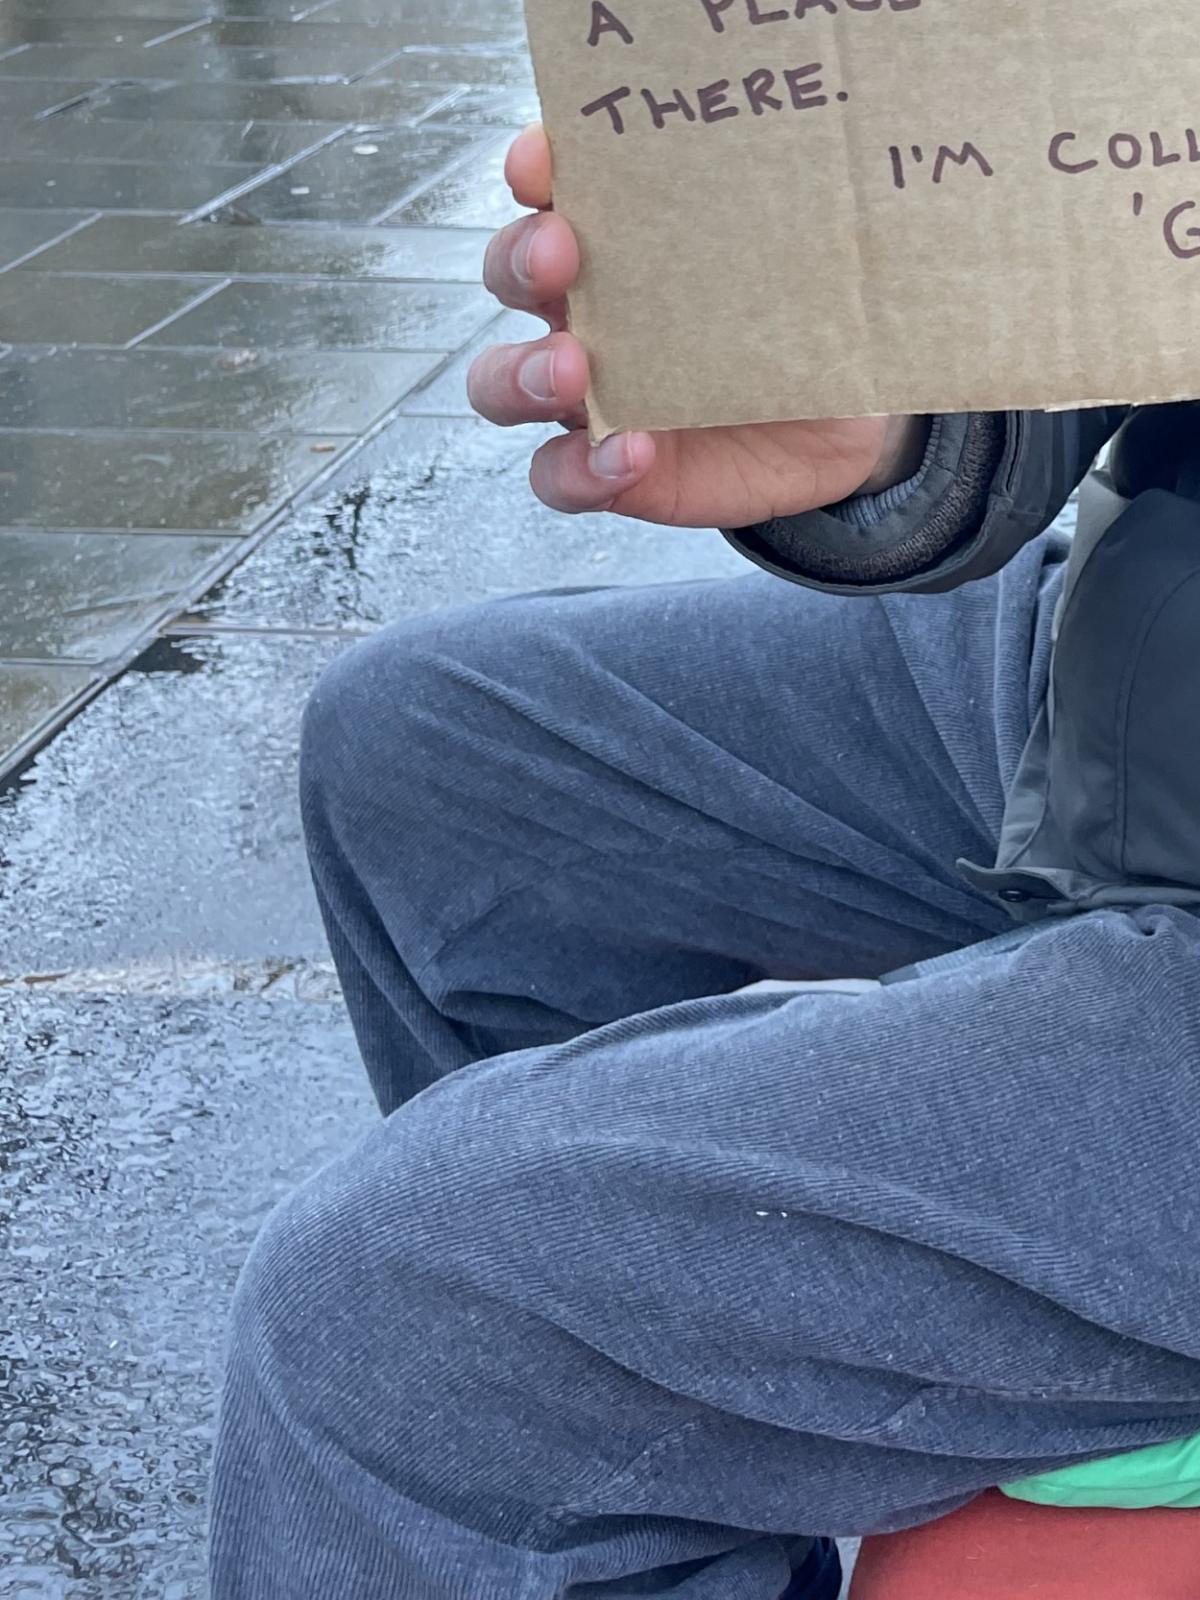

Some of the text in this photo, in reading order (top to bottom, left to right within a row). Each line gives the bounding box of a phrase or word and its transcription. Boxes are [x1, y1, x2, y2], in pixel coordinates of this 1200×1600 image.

[586, 0, 634, 47] A
[580, 62, 850, 135] THERE.
[887, 141, 994, 190] I'M
